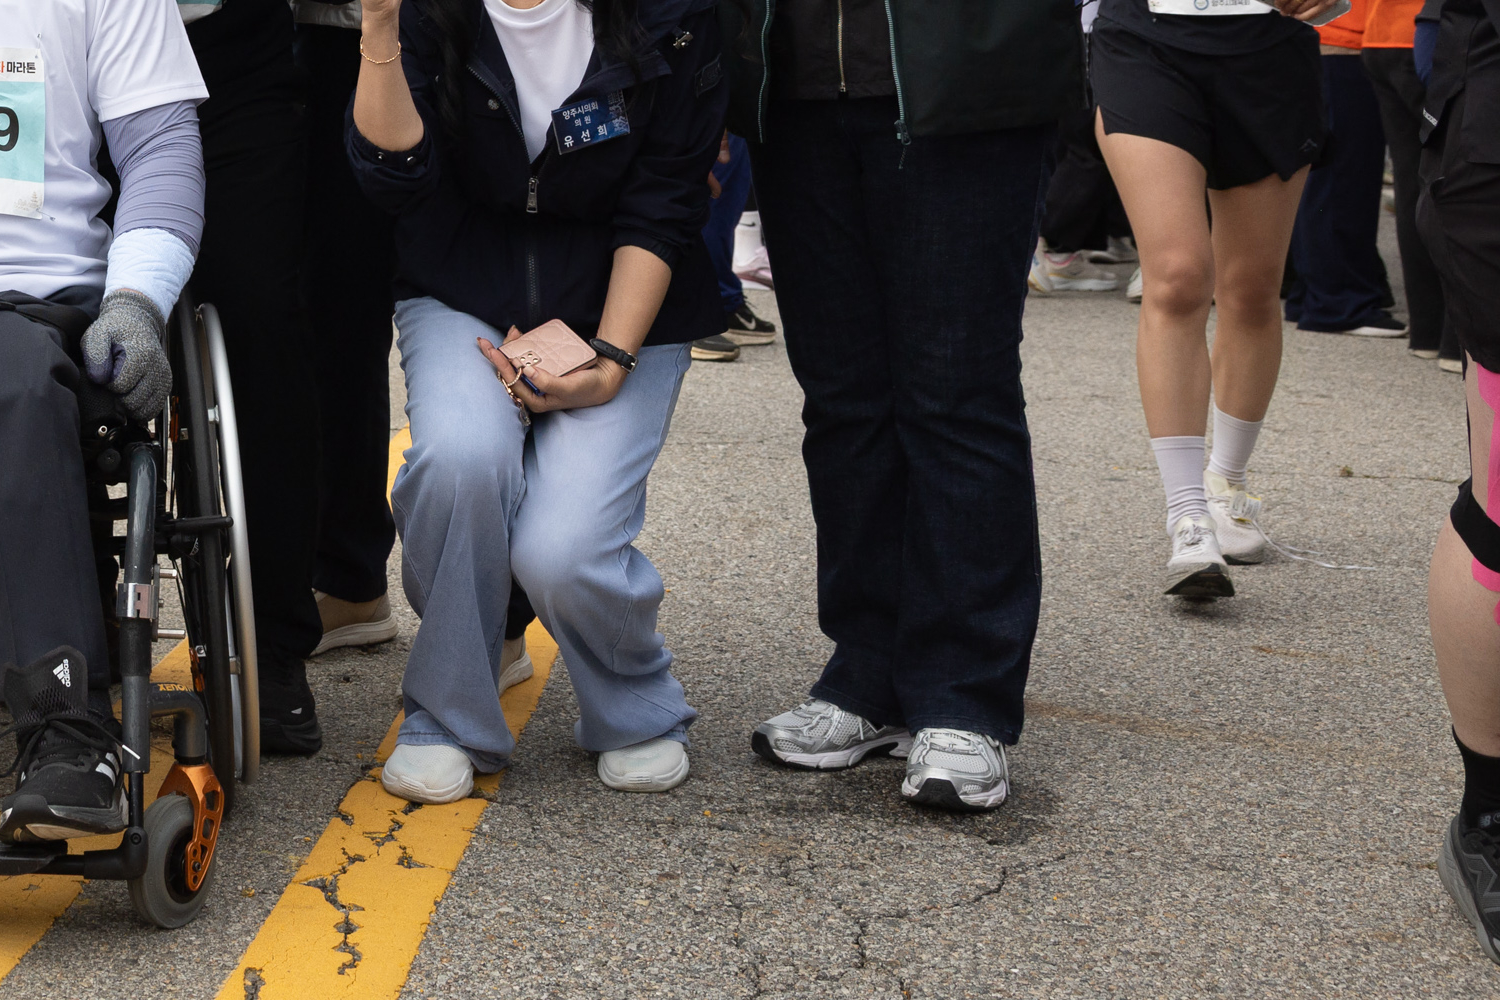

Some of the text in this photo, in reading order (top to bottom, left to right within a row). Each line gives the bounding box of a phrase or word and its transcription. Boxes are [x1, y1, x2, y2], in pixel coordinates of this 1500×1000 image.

[6, 61, 36, 74] 마라톤
[562, 101, 599, 120] 양주시의회
[574, 115, 592, 127] 의원
[564, 124, 608, 148] 유선희
[62, 658, 71, 688] adidas
